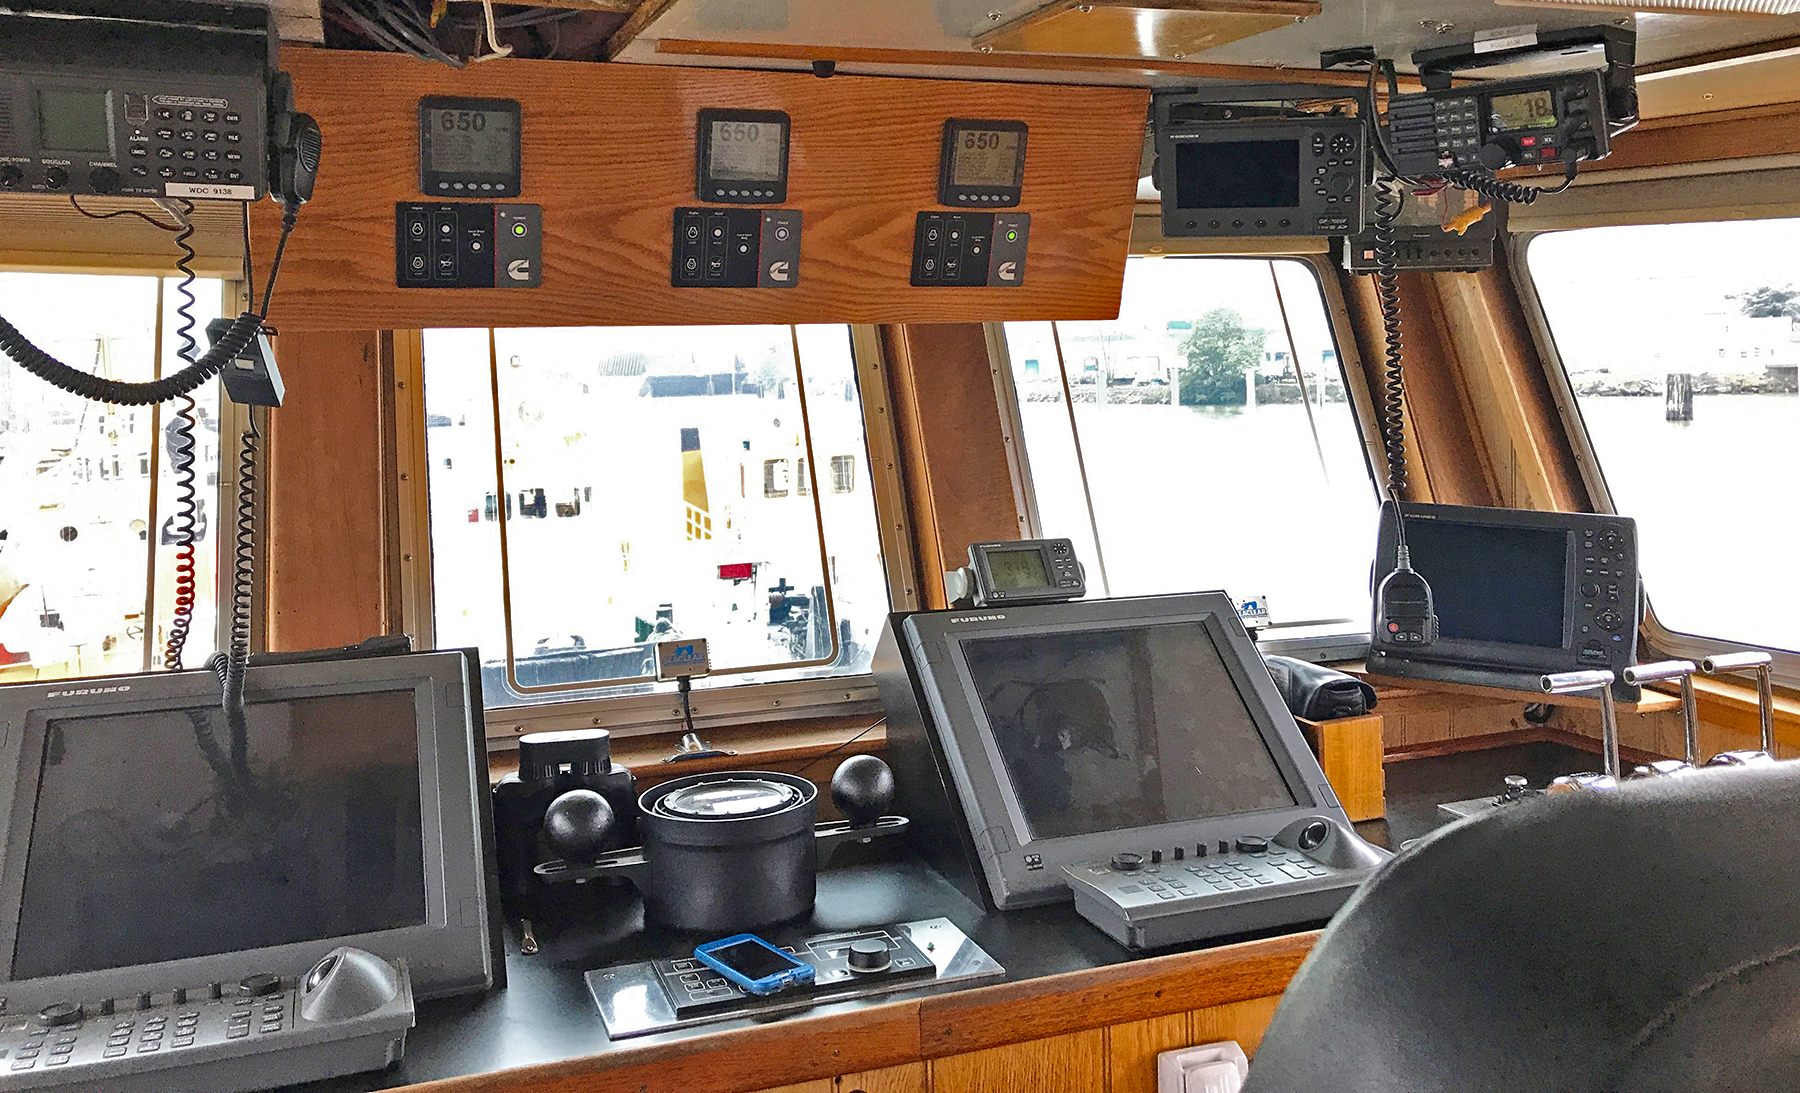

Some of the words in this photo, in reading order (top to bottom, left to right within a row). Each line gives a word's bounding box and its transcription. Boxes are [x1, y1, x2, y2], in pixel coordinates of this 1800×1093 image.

[1523, 97, 1548, 117] 18
[440, 111, 486, 132] 650
[718, 123, 760, 142] 650
[964, 132, 1000, 150] 650
[212, 187, 232, 195] 9138
[950, 614, 1006, 624] FURUNO
[46, 685, 131, 698] FURUNO
